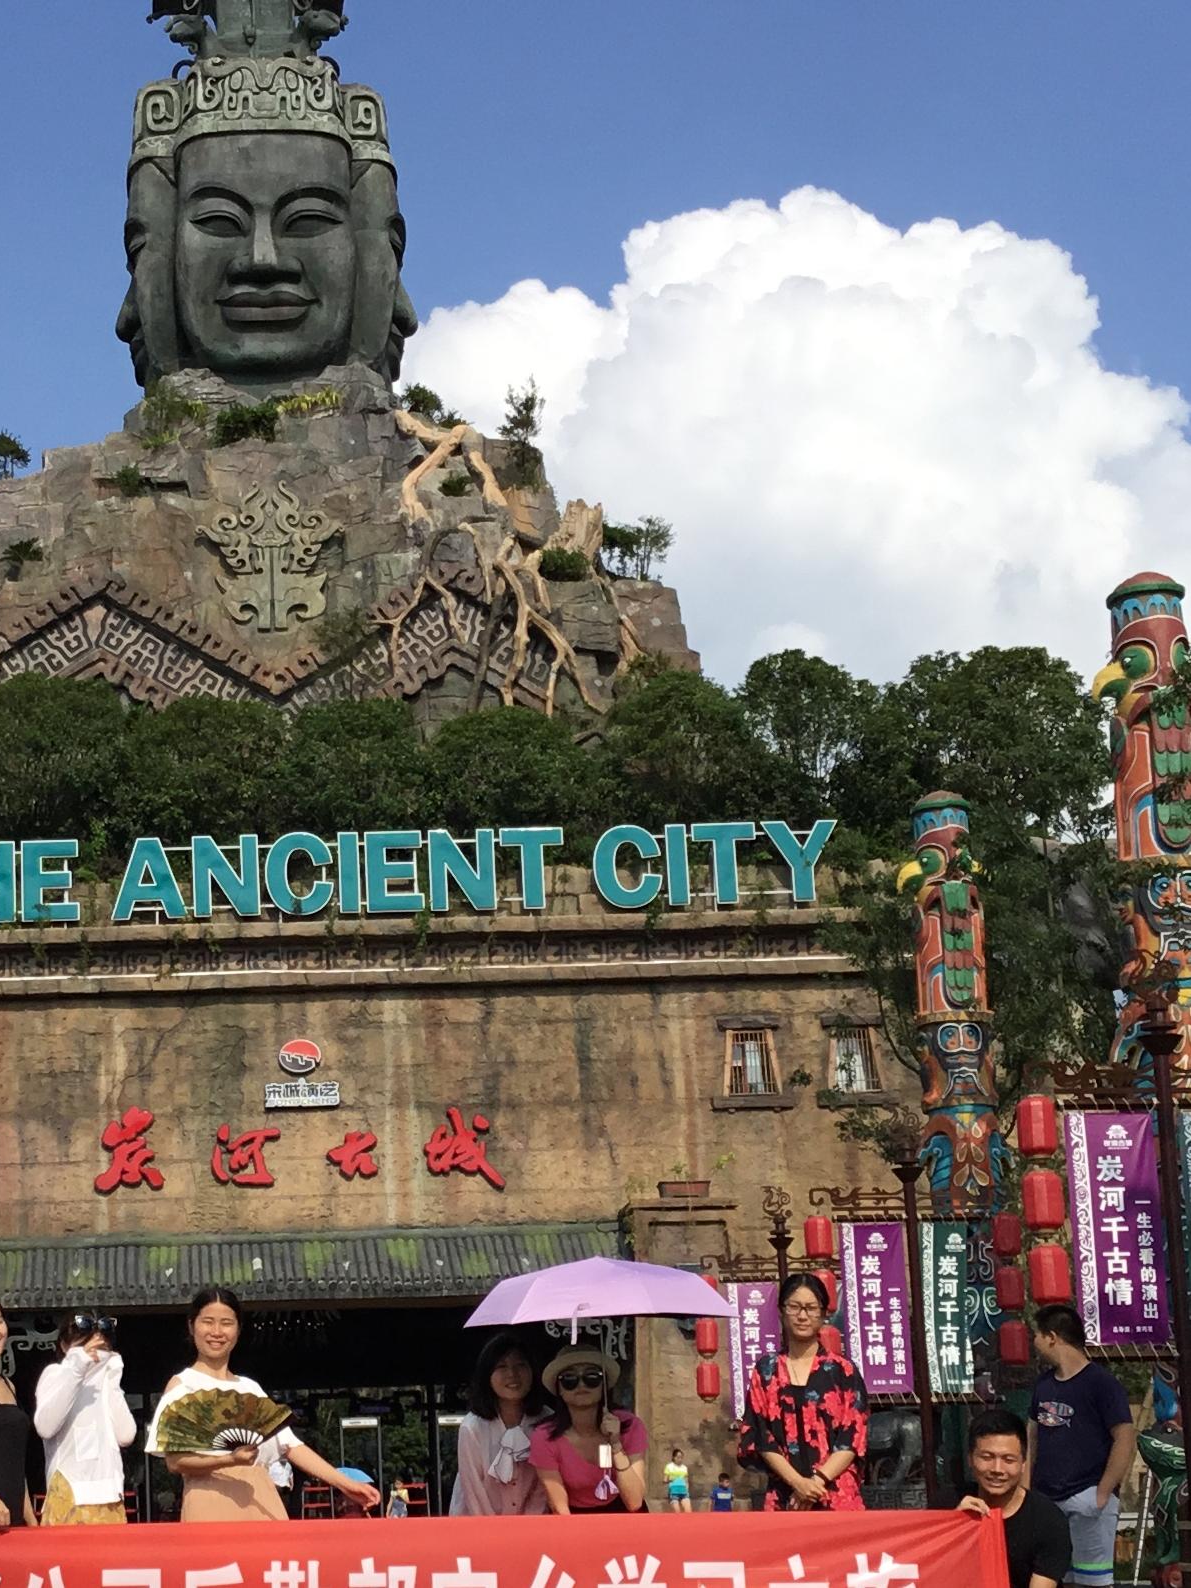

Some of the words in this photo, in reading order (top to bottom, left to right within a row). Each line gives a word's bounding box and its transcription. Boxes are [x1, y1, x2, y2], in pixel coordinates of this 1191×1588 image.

[110, 826, 564, 920] ANCIENT
[592, 819, 838, 908] CITY
[94, 1105, 507, 1195] 炭河古城
[1096, 1155, 1134, 1307] 炭河千古情
[1134, 1200, 1159, 1320] 一生必看的演出
[860, 1255, 888, 1366] 炭河千古情
[887, 1287, 907, 1375] 一生必看的演出
[938, 1256, 961, 1367] 炭河千古情
